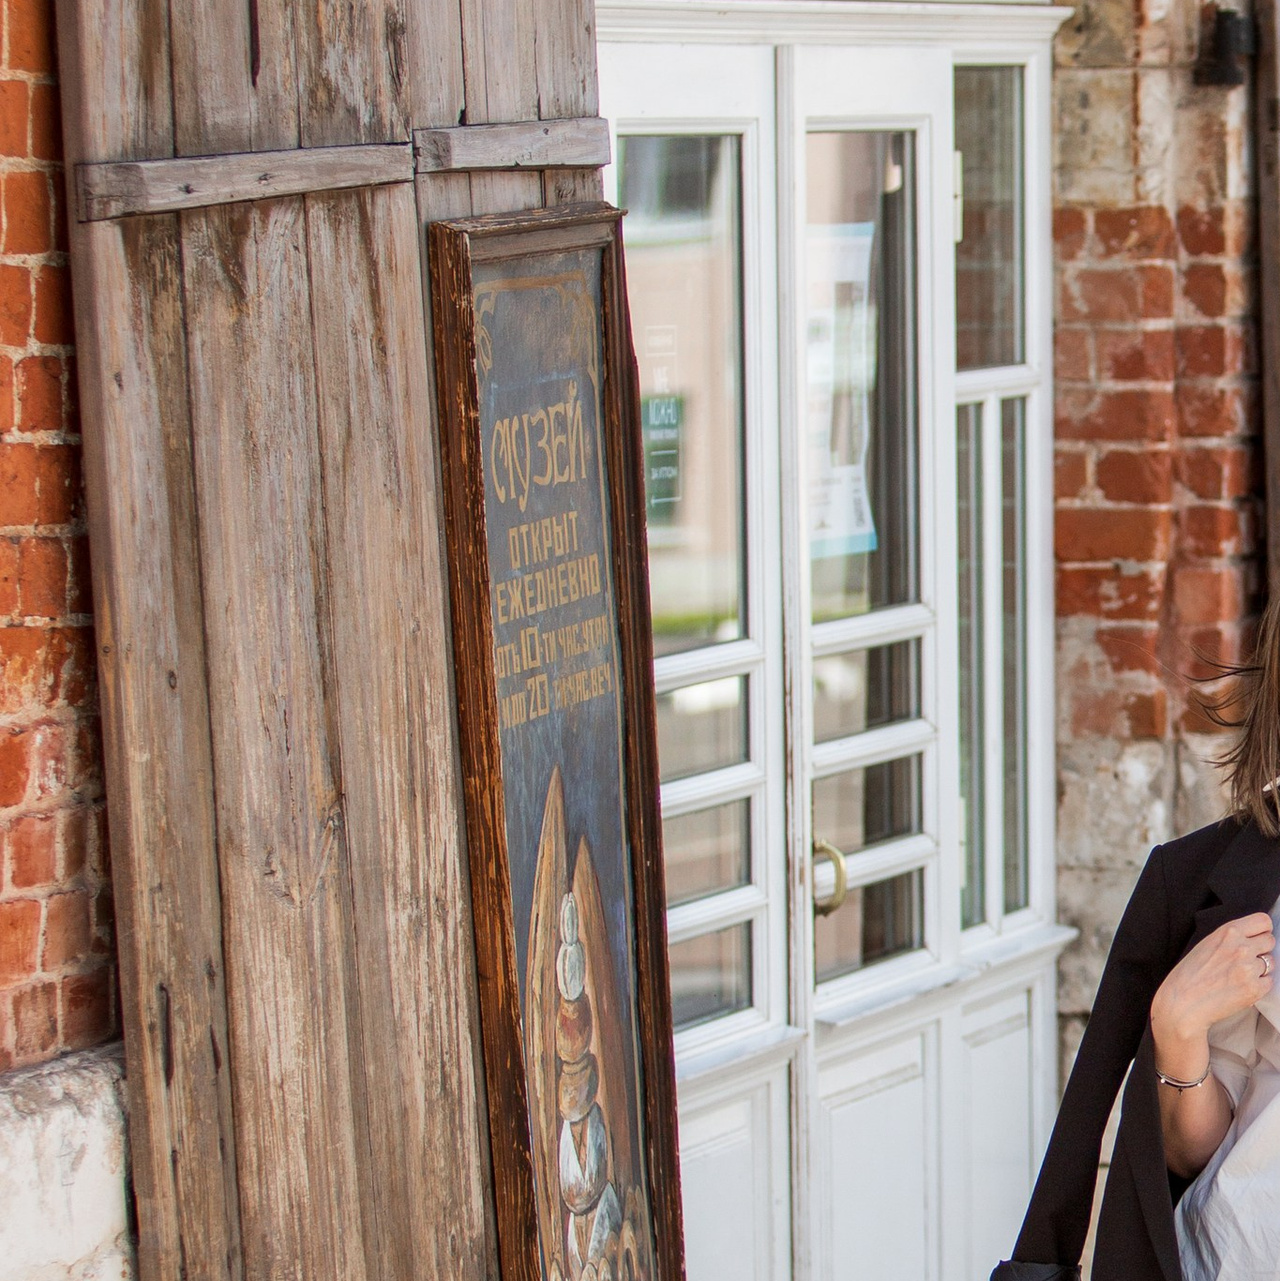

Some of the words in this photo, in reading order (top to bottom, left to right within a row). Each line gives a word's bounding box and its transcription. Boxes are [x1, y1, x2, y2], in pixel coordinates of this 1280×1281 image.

[490, 379, 587, 513] МУЗЕЙ
[508, 510, 579, 570] ОТКРЫТ
[495, 552, 601, 625] ЕЖЕДНЕВНО
[496, 642, 521, 679] ОТЪ
